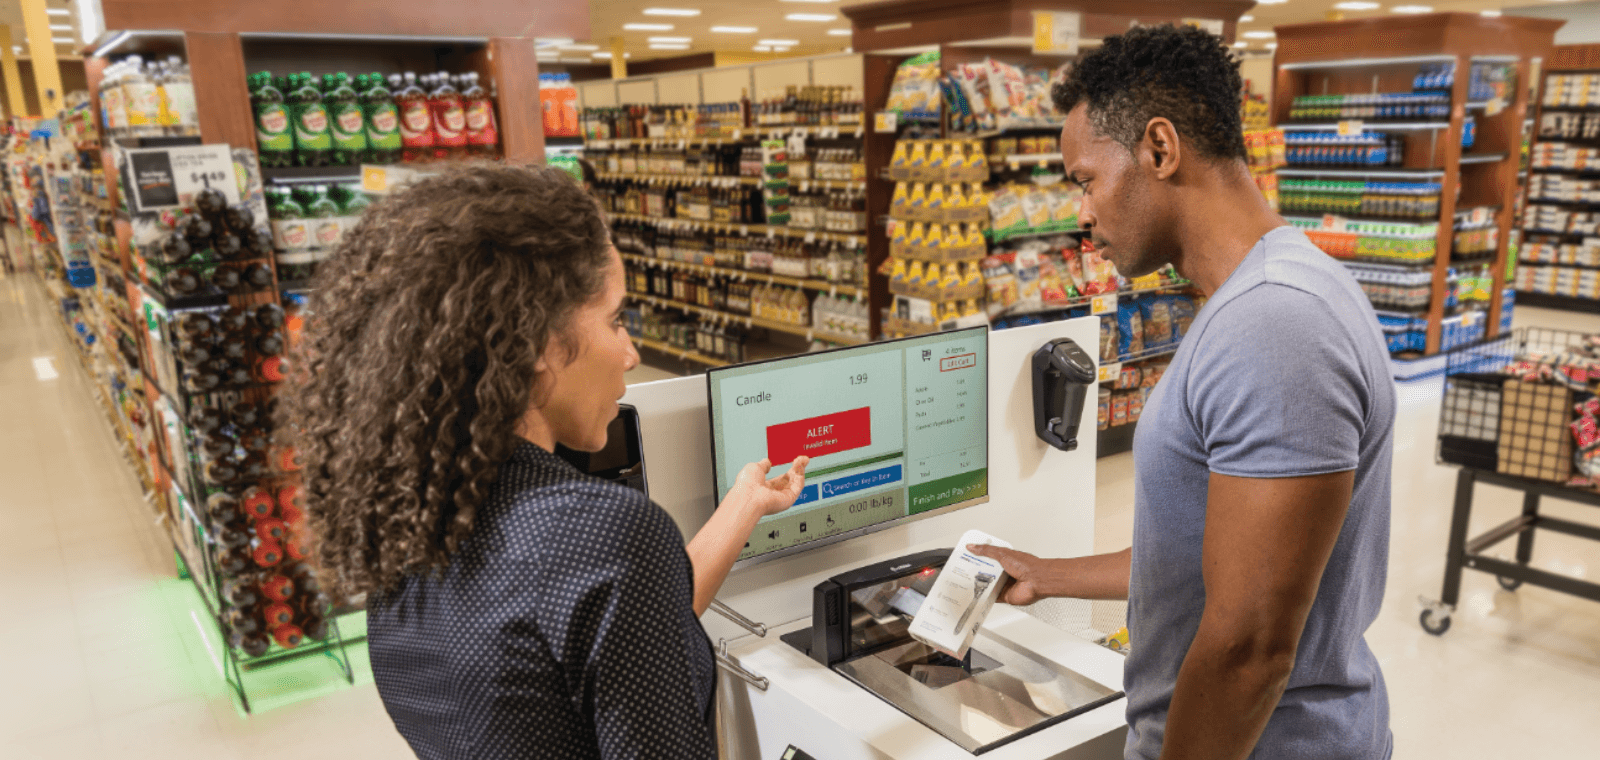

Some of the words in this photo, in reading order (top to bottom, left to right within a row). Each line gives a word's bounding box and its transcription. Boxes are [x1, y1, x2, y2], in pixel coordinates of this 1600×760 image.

[849, 373, 868, 386] 1.99
[736, 391, 772, 406] Candle
[806, 424, 834, 439] ALERT
[803, 439, 823, 450] Invalid
[833, 481, 853, 492] Search
[861, 477, 871, 486] Key
[913, 494, 935, 506] Finish
[936, 489, 951, 501] and
[951, 486, 965, 497] Pay
[849, 500, 868, 514] 0.00
[870, 495, 893, 509] lb/kg
